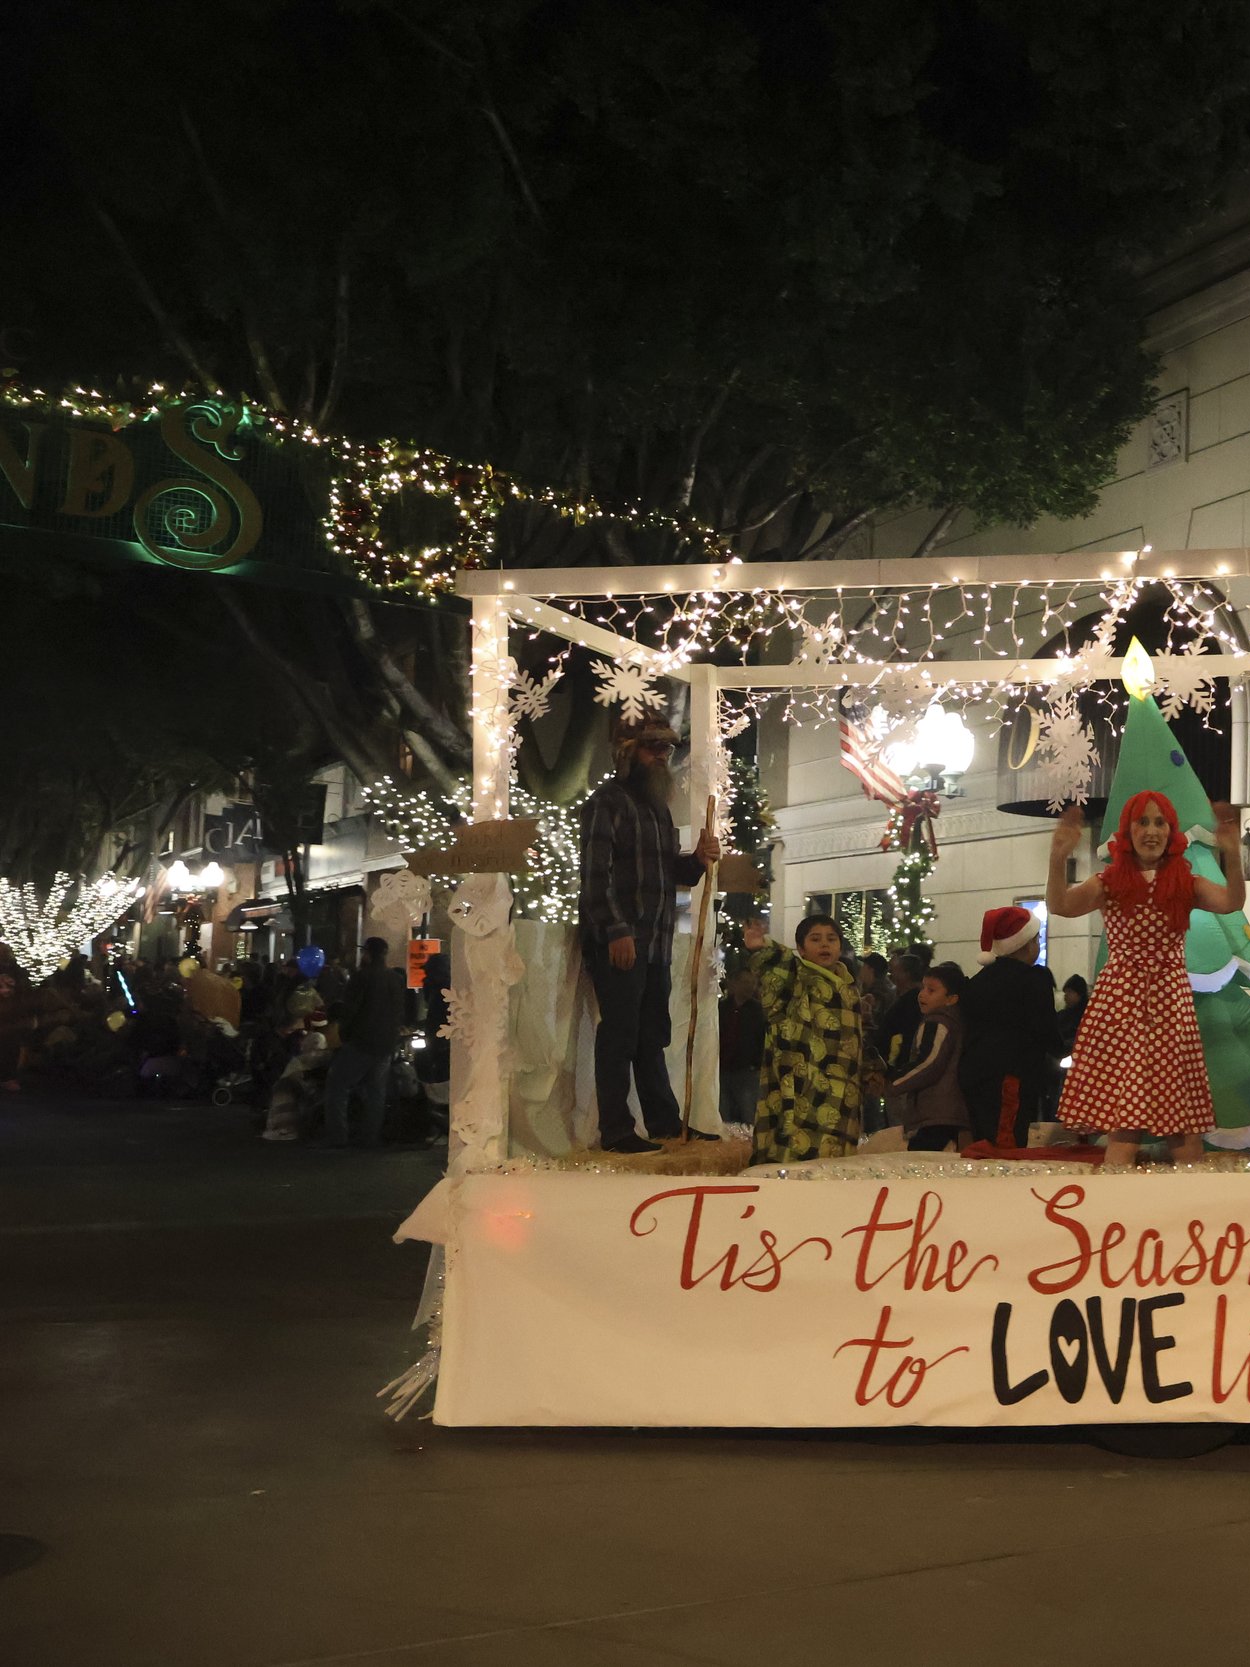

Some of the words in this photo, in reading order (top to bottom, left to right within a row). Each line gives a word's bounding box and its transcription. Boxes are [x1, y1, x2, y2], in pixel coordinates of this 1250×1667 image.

[841, 1186, 999, 1293] the
[833, 1305, 970, 1408] to
[991, 1292, 1195, 1406] LOVE
